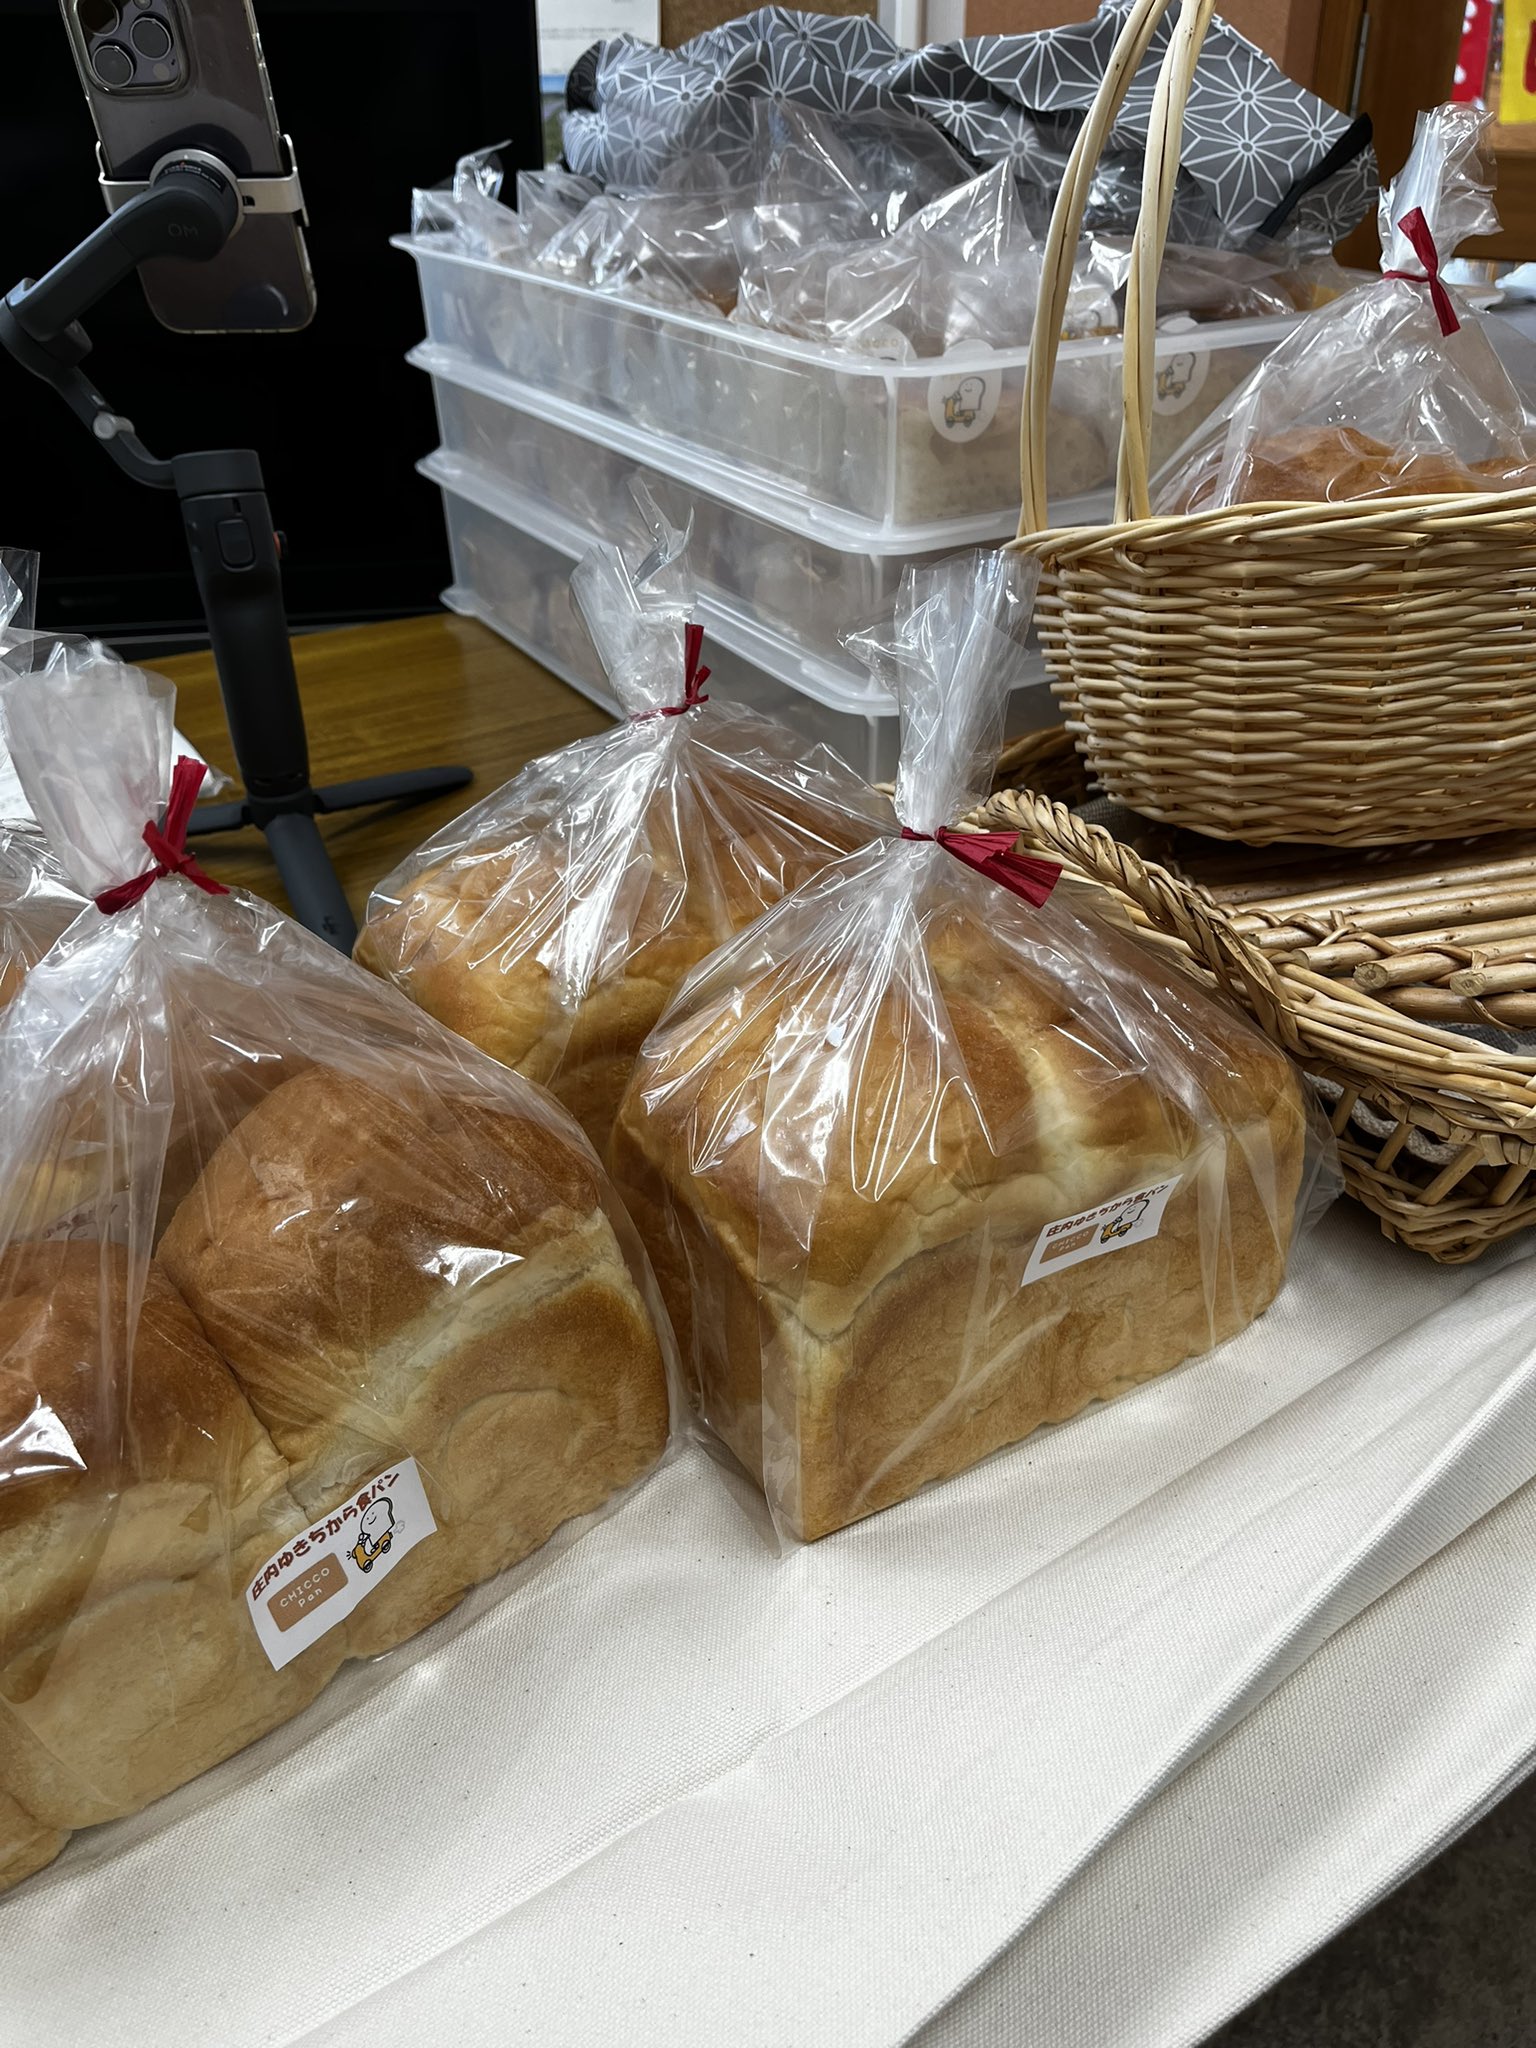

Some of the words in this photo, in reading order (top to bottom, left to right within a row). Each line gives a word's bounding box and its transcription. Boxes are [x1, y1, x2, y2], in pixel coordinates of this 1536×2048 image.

[168, 223, 199, 240] OM
[251, 1472, 400, 1602] 庄内ゆきちから食パン
[279, 1567, 331, 1608] CHICCO
[298, 1588, 323, 1608] Pan
